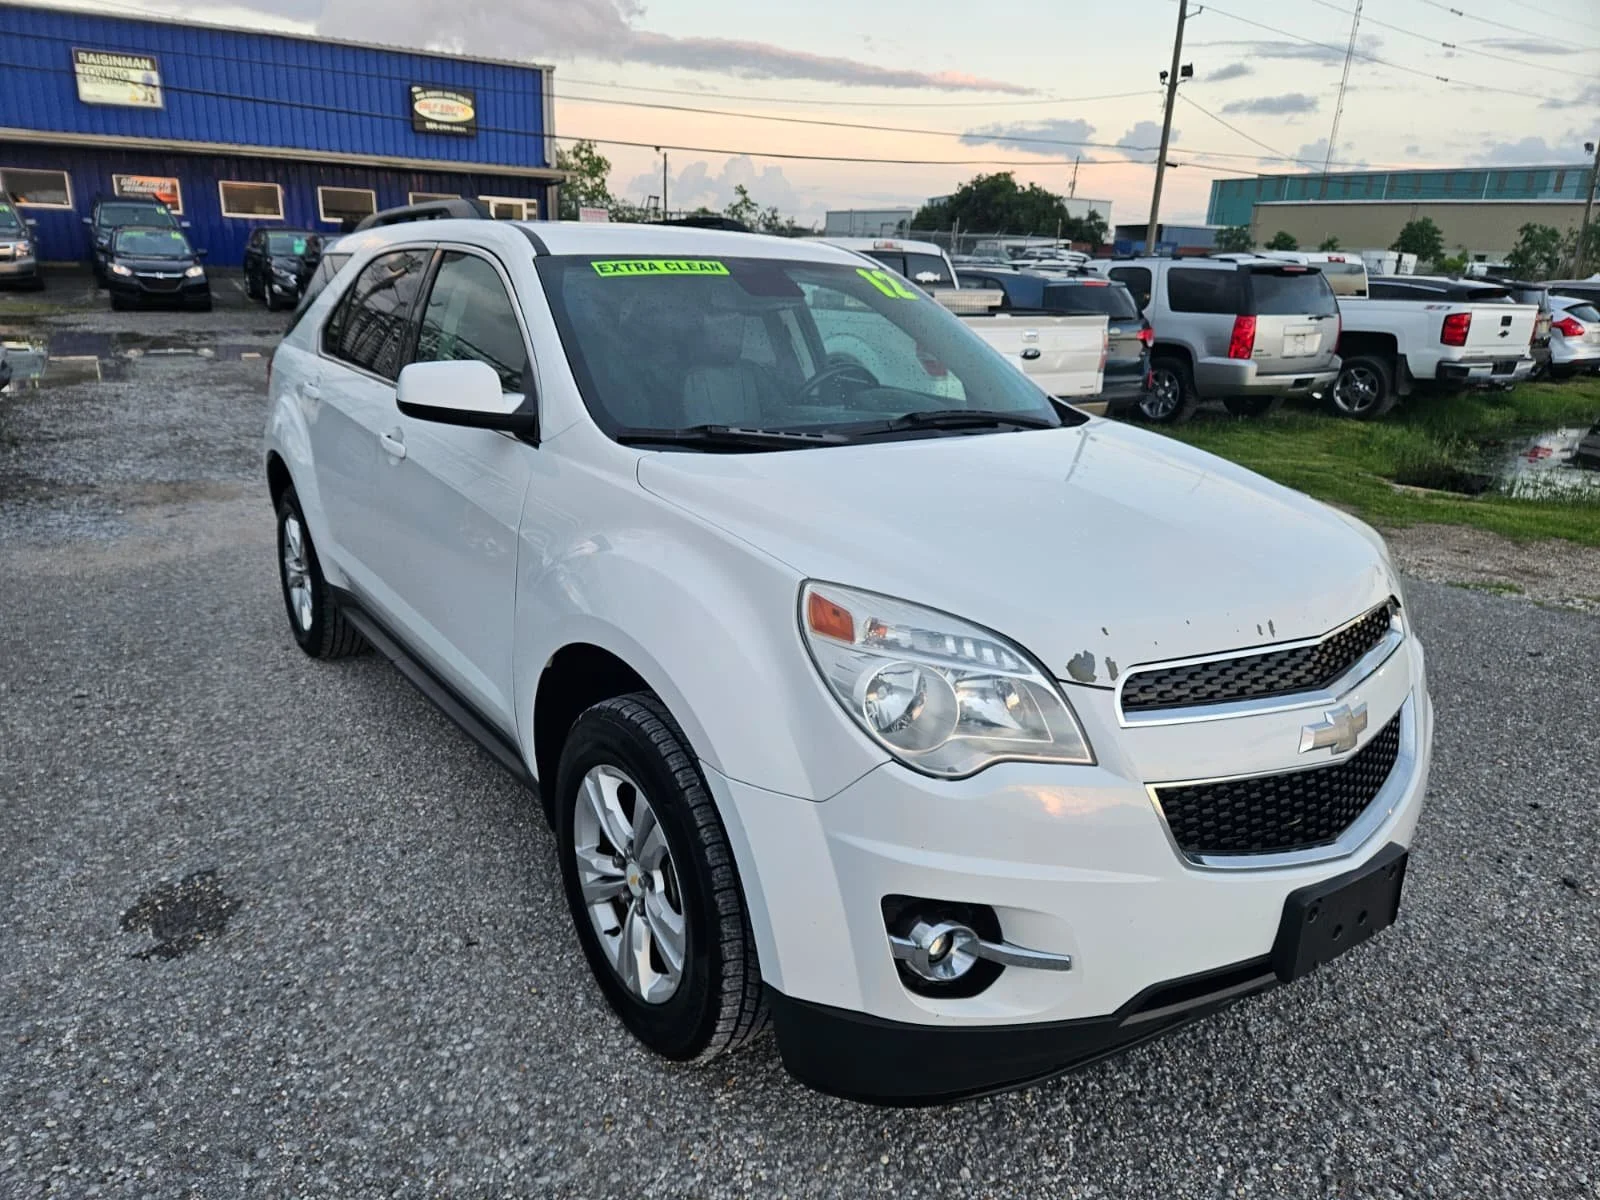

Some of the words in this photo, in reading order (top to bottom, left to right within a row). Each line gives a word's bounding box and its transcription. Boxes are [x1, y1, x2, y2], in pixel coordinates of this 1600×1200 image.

[77, 52, 151, 69] RAISINMAN
[597, 262, 660, 274] EXTRA
[664, 262, 721, 272] CLEAN
[855, 266, 920, 300] 12
